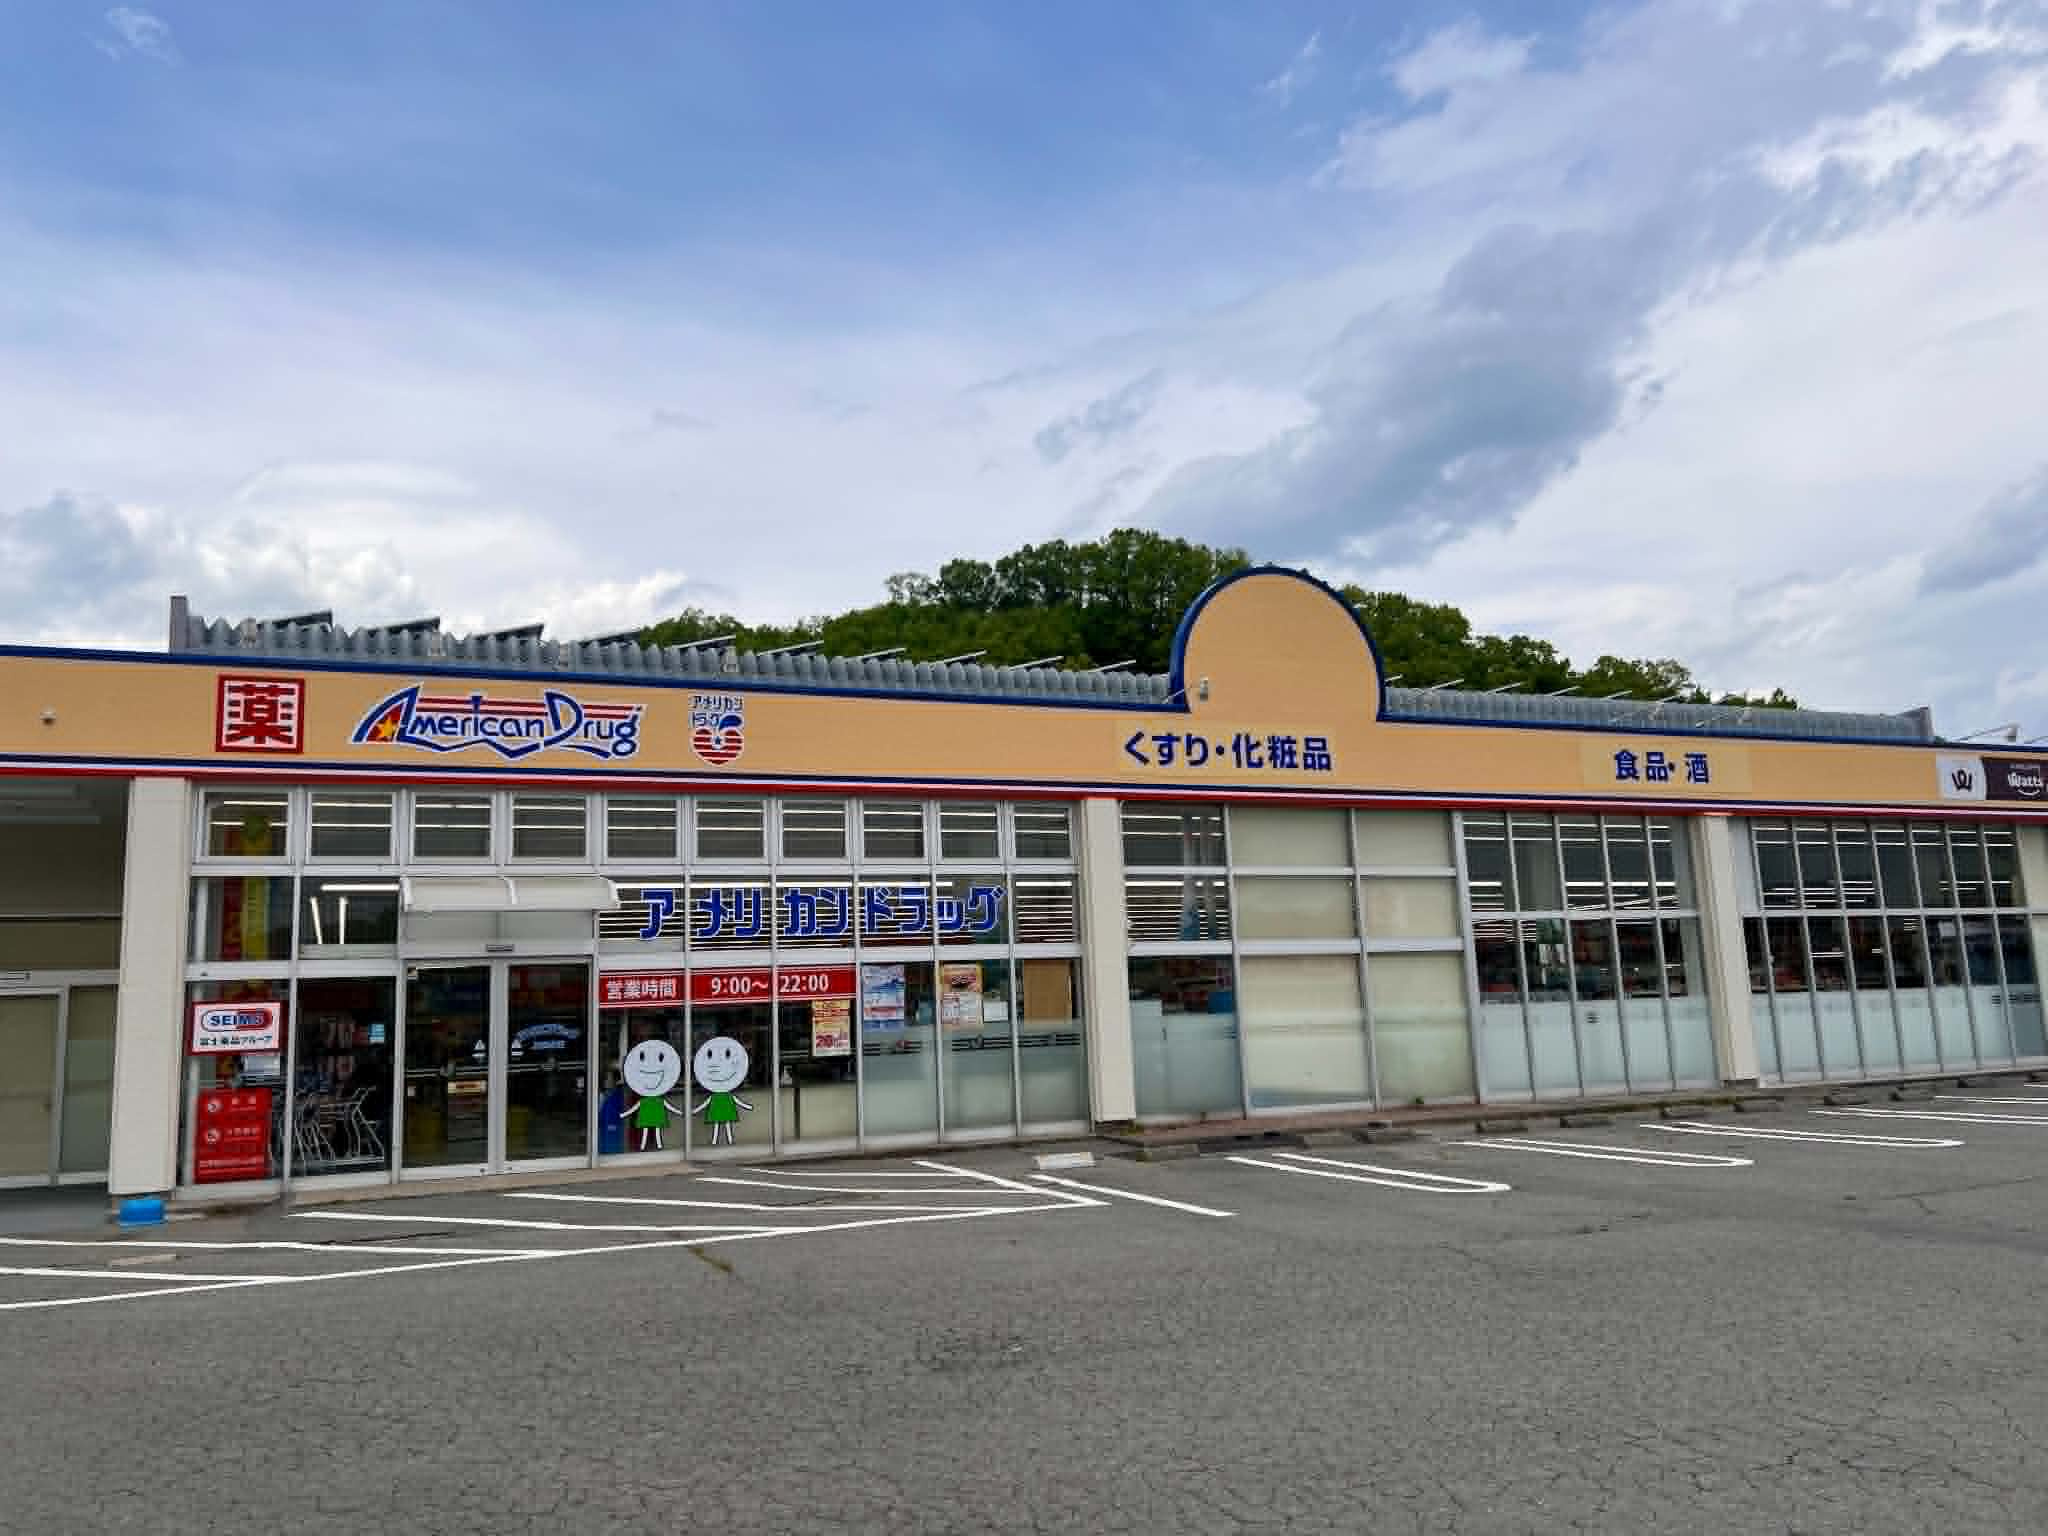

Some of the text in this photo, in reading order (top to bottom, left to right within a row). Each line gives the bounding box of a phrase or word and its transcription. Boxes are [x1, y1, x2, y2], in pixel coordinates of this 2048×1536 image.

[224, 681, 297, 746] 薬
[351, 685, 643, 757] American Drug
[1124, 731, 1332, 771] くすり・化粧品
[605, 980, 678, 1000] 営業時間
